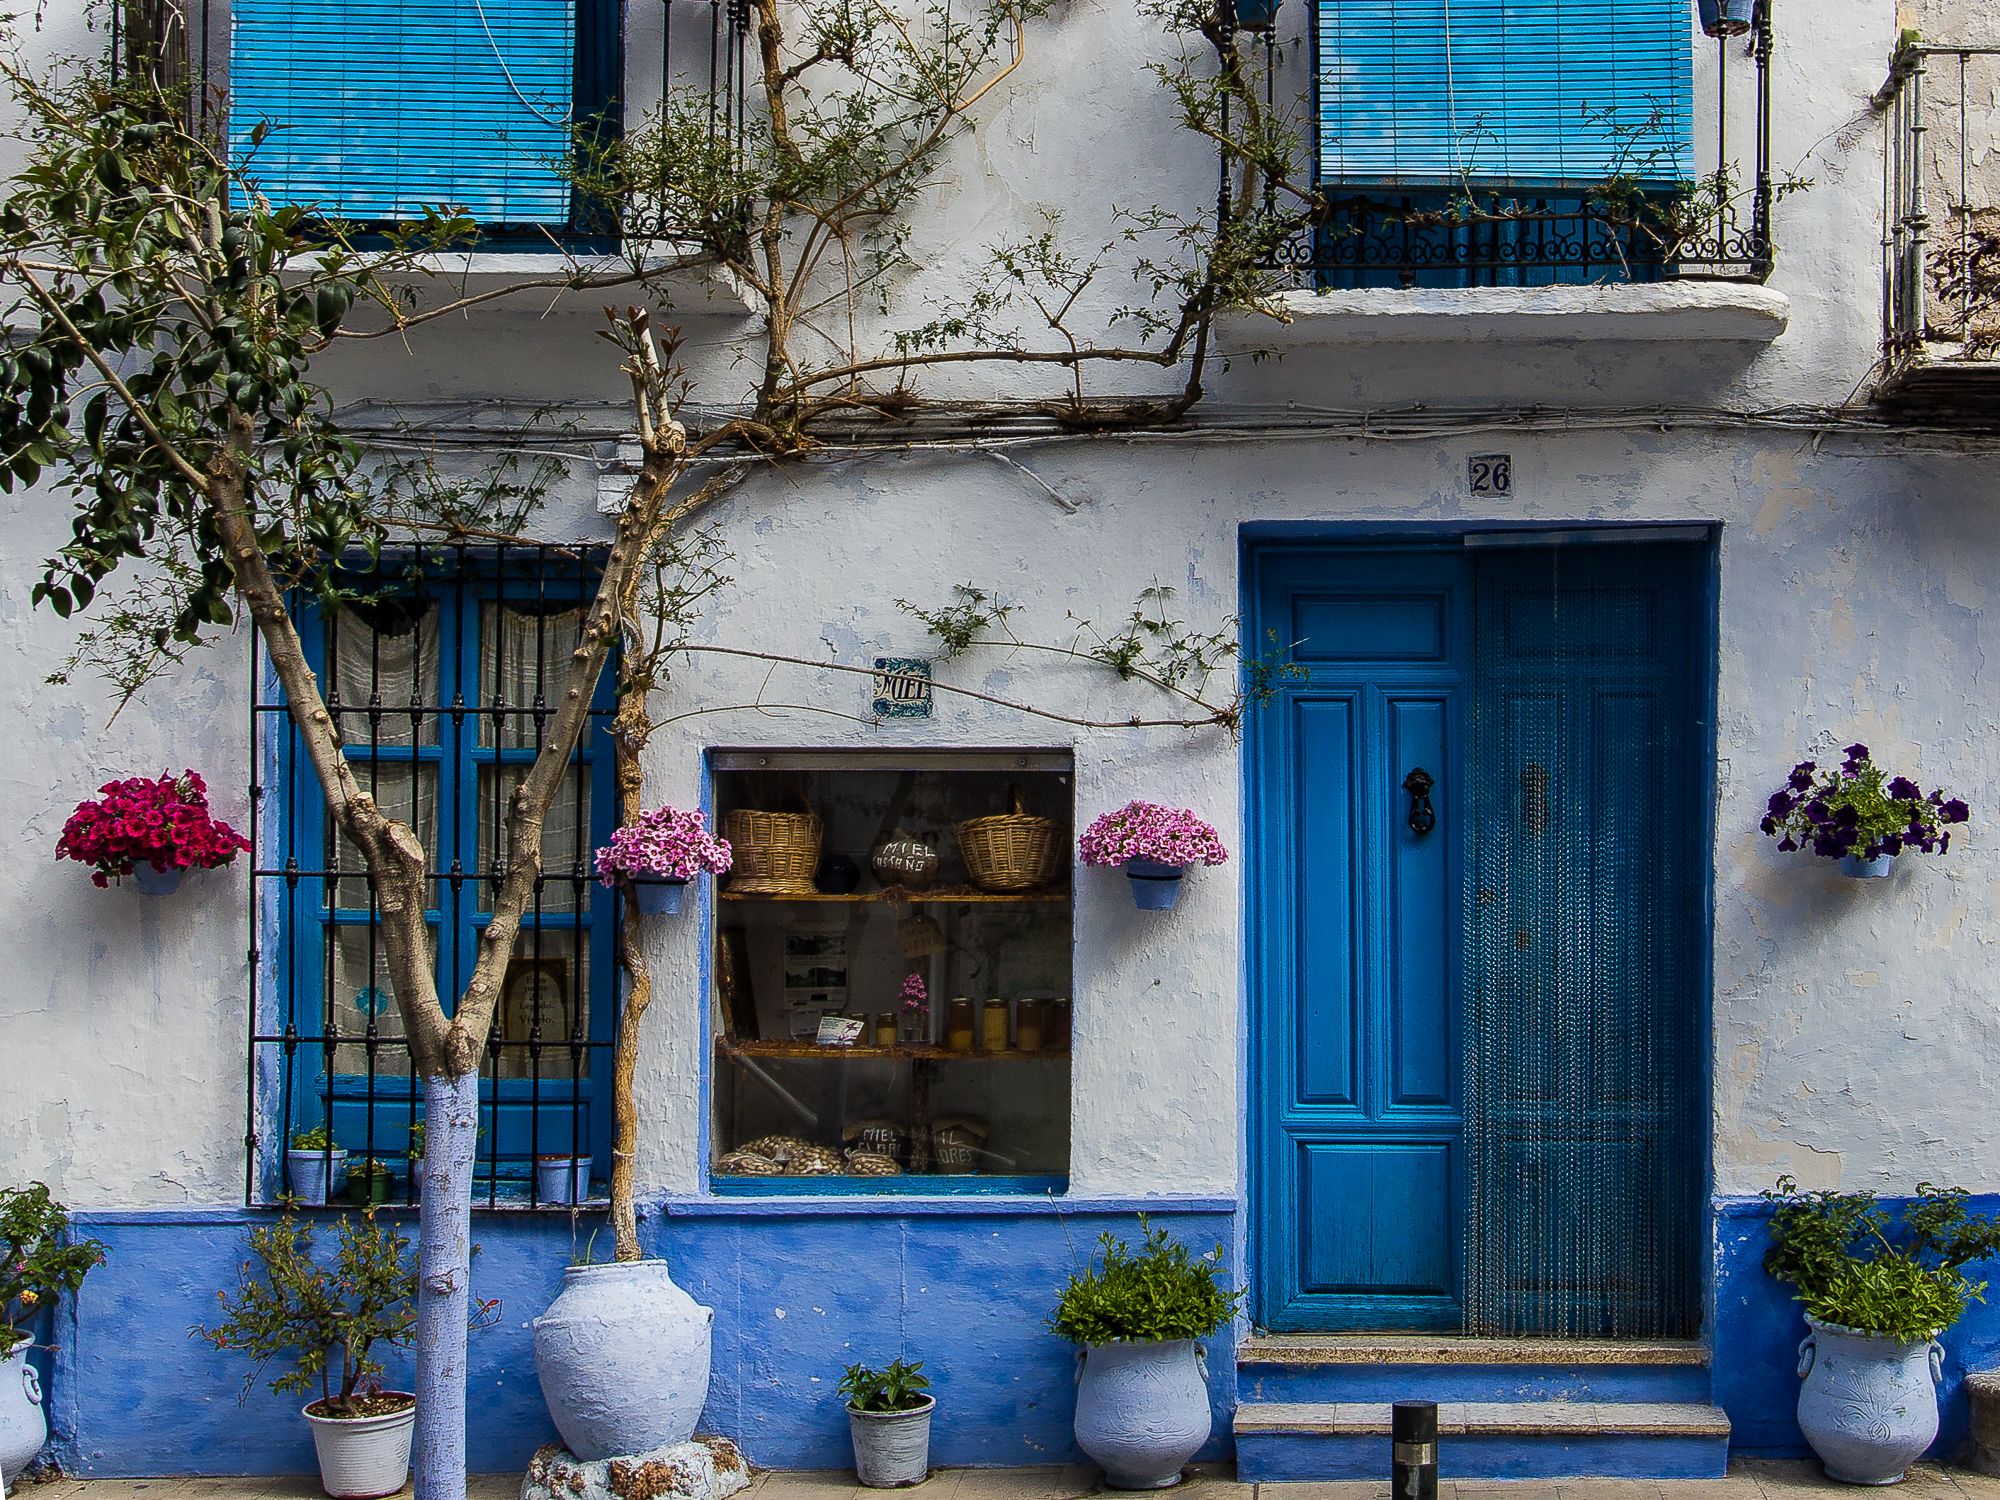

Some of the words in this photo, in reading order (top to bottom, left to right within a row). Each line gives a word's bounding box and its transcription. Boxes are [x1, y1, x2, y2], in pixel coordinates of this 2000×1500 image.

[1472, 462, 1510, 491] 26
[883, 842, 936, 858] MIEL
[524, 986, 548, 994] pate
[529, 992, 543, 1001] dl
[519, 1000, 554, 1011] Legdo.
[863, 1127, 897, 1142] MIEL
